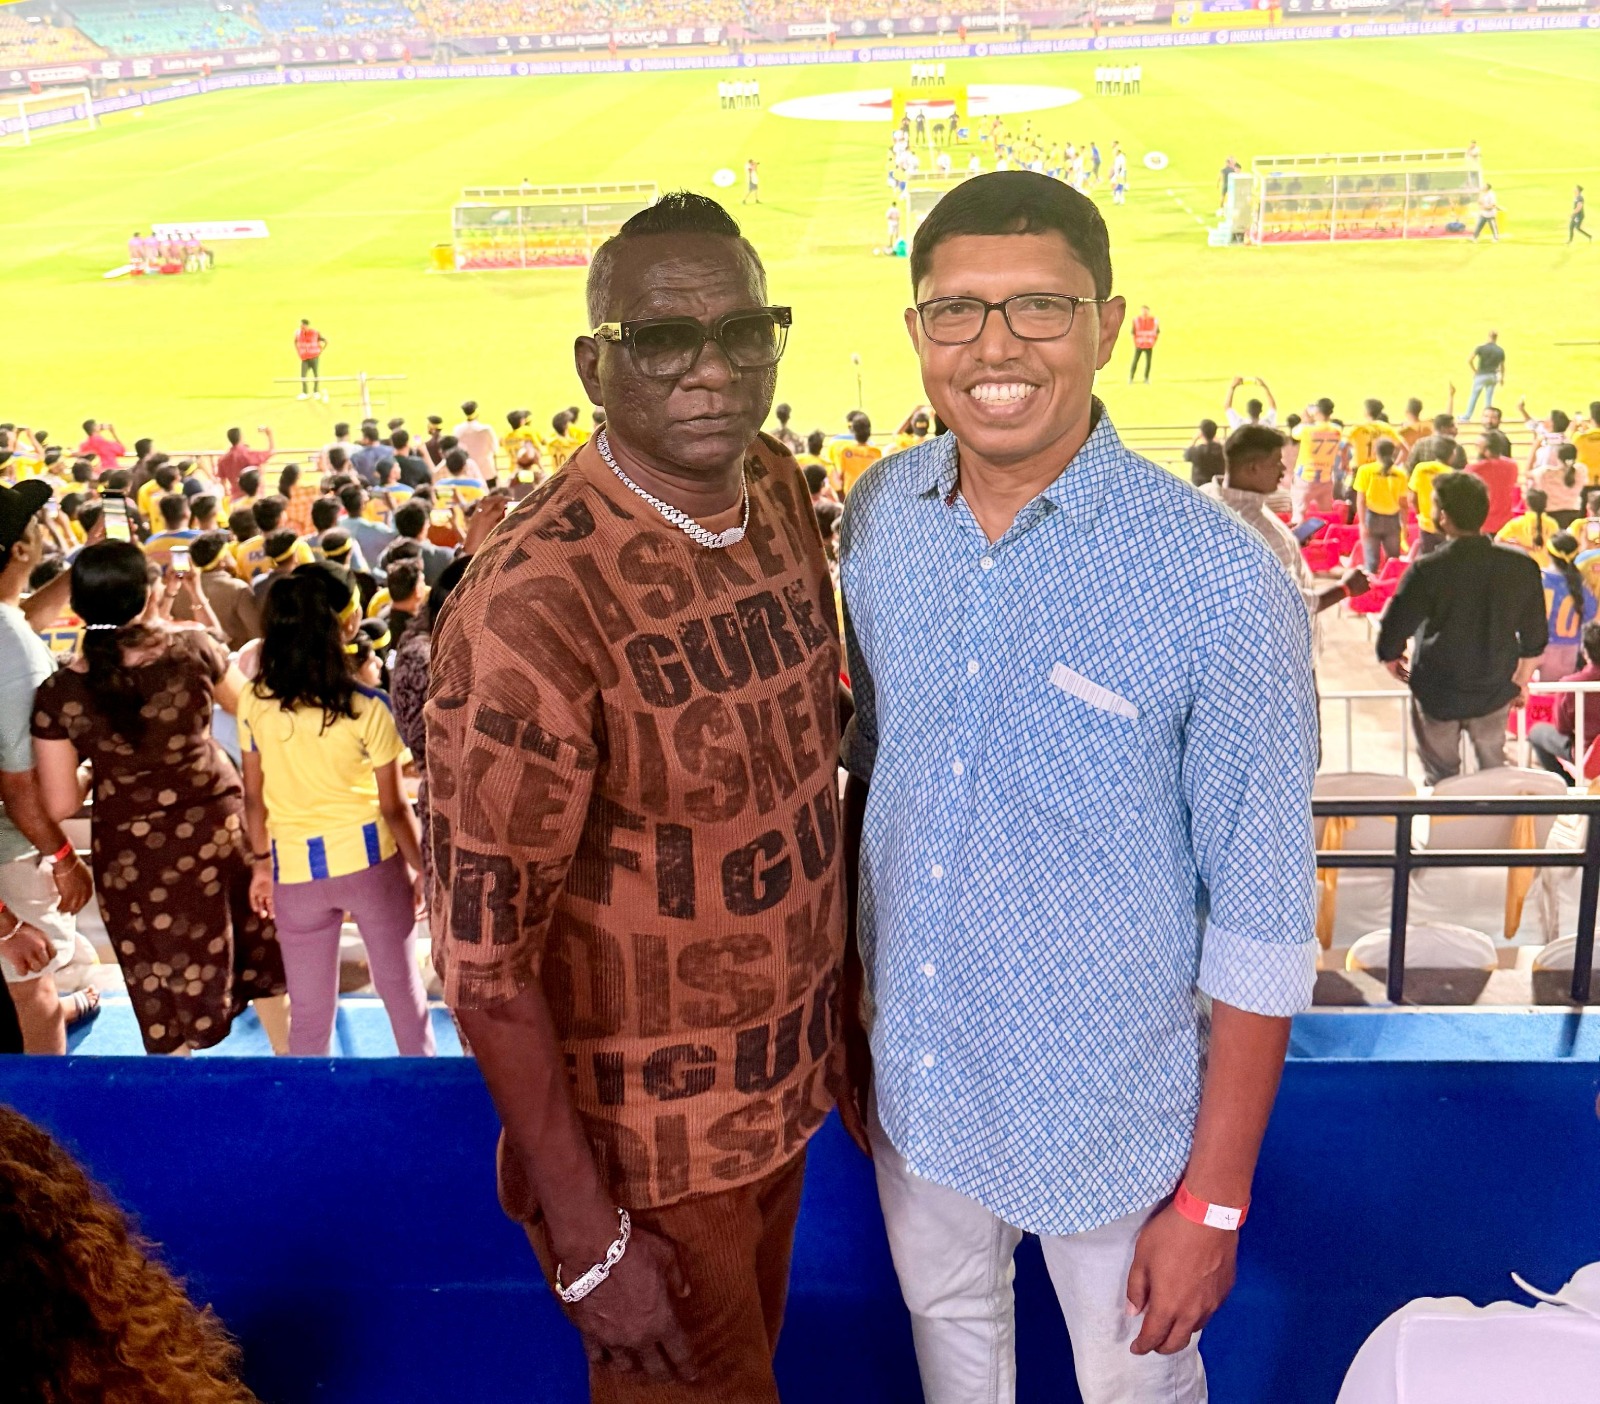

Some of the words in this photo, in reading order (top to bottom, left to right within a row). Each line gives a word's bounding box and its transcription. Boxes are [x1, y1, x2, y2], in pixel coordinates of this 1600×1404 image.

[1353, 24, 1387, 36] INDIAN
[1388, 22, 1418, 34] SUPER
[1420, 21, 1457, 33] LEAGUE
[1477, 19, 1510, 31] INDIAN
[1511, 17, 1542, 29] SUPER
[1544, 15, 1580, 28] LEAGUE
[613, 30, 668, 44] POLYCAB
[1108, 36, 1141, 48] INDIAN
[1142, 35, 1173, 46] SUPER
[1174, 33, 1210, 45] LEAGUE
[1230, 30, 1263, 42] INDIAN
[1264, 28, 1295, 40] SUPER
[1296, 26, 1333, 38] LEAGUE
[872, 48, 904, 60] INDIAN
[905, 47, 933, 59] SUPER
[935, 45, 970, 57] LEAGUE
[989, 42, 1021, 54] INDIAN
[1022, 41, 1052, 53] SUPER
[1053, 39, 1089, 51] LEAGUE
[643, 58, 674, 70] INDIAN
[675, 57, 703, 69] SUPER
[704, 55, 738, 68] LEAGUE
[756, 53, 788, 65] INDIAN
[789, 52, 818, 64] SUPER
[819, 51, 853, 62] LEAGUE
[303, 69, 335, 82] INDIAN
[336, 69, 364, 80] SUPER
[365, 67, 399, 80] LEAGUE
[416, 65, 447, 78] INDIAN
[448, 64, 477, 77] SUPER
[478, 63, 511, 76] LEAGUE
[529, 62, 560, 74] INDIAN
[561, 61, 590, 73] SUPER
[591, 60, 624, 72] LEAGUE
[1311, 438, 1340, 455] 77
